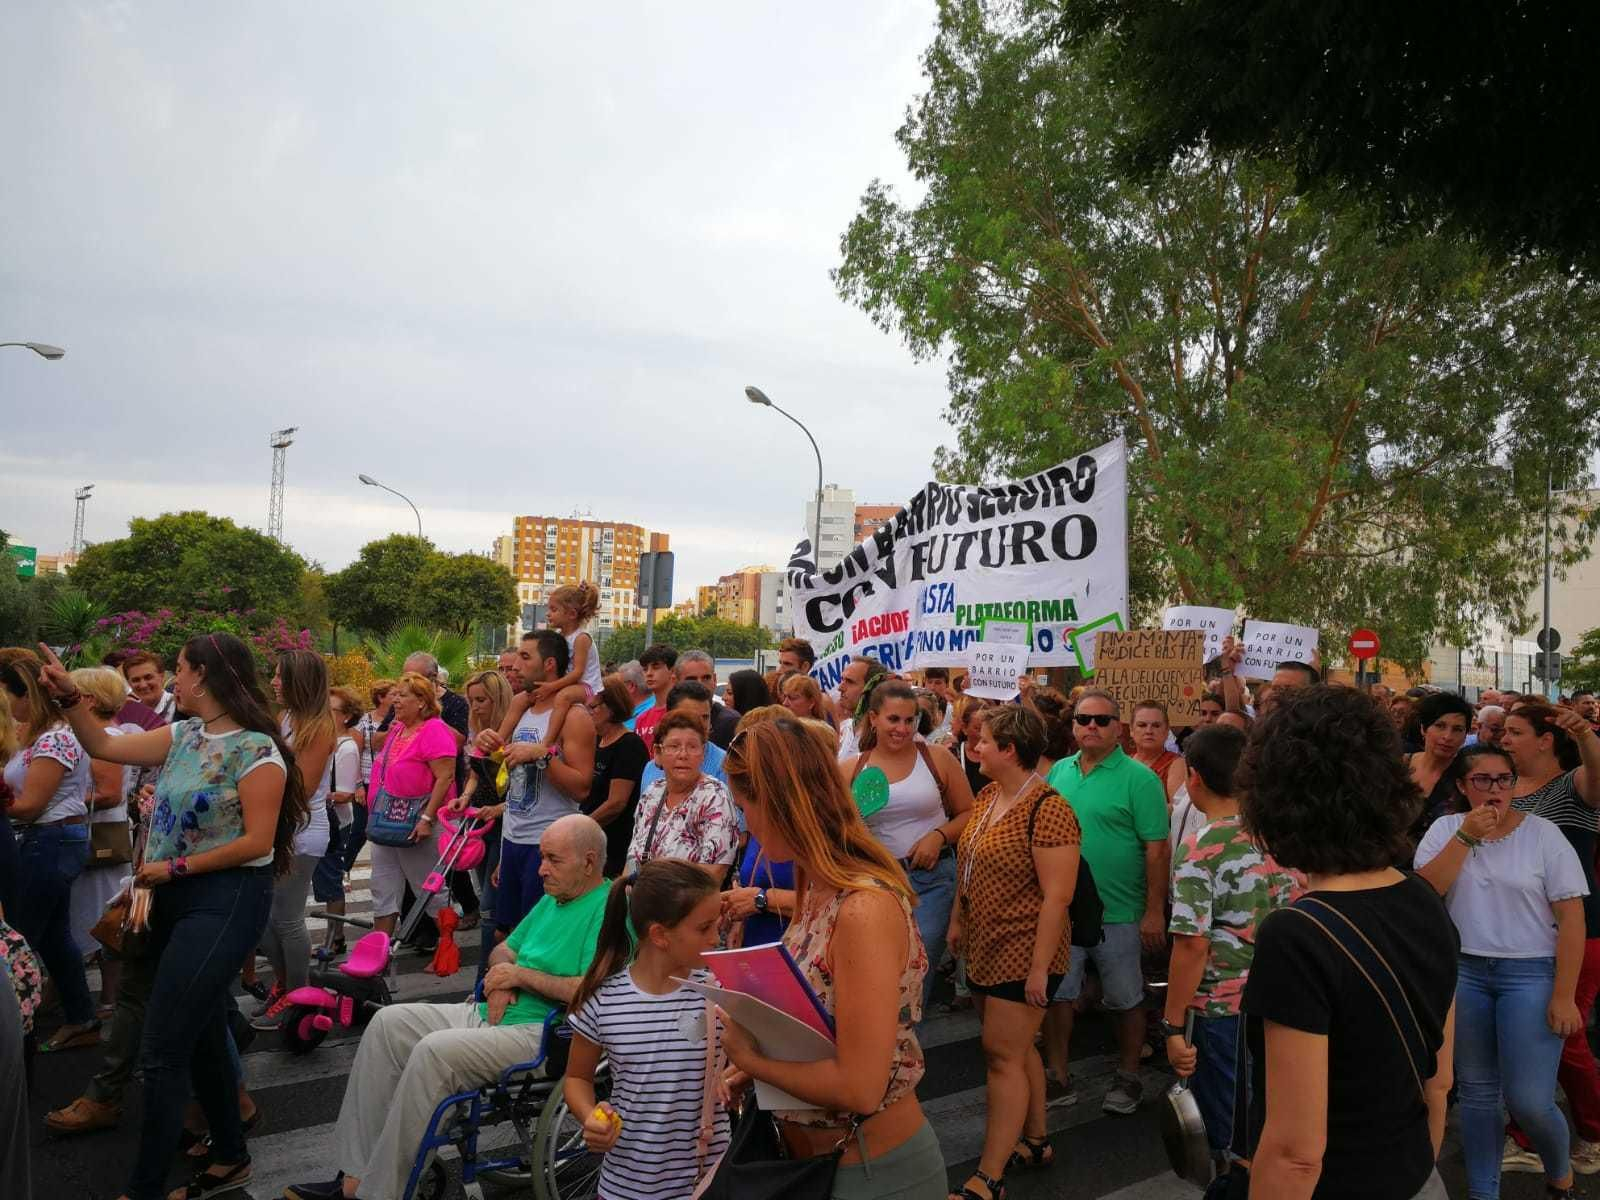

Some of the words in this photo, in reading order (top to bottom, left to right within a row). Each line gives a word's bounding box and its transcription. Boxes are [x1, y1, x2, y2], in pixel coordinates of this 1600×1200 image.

[911, 514, 1098, 581] FUTURO
[955, 598, 1079, 627] PLATAFORMA
[1170, 618, 1191, 628] POR
[1200, 619, 1216, 629] UN
[1256, 632, 1277, 642] POR
[1285, 635, 1303, 646] UN
[976, 652, 995, 662] POR
[1001, 655, 1015, 664] UN
[1154, 644, 1196, 660] BASTA
[1247, 644, 1303, 659] BARRIO
[1245, 657, 1261, 667] CON
[971, 665, 1016, 678] BARRIO
[972, 678, 988, 687] CON
[988, 679, 1017, 690] FUTURO
